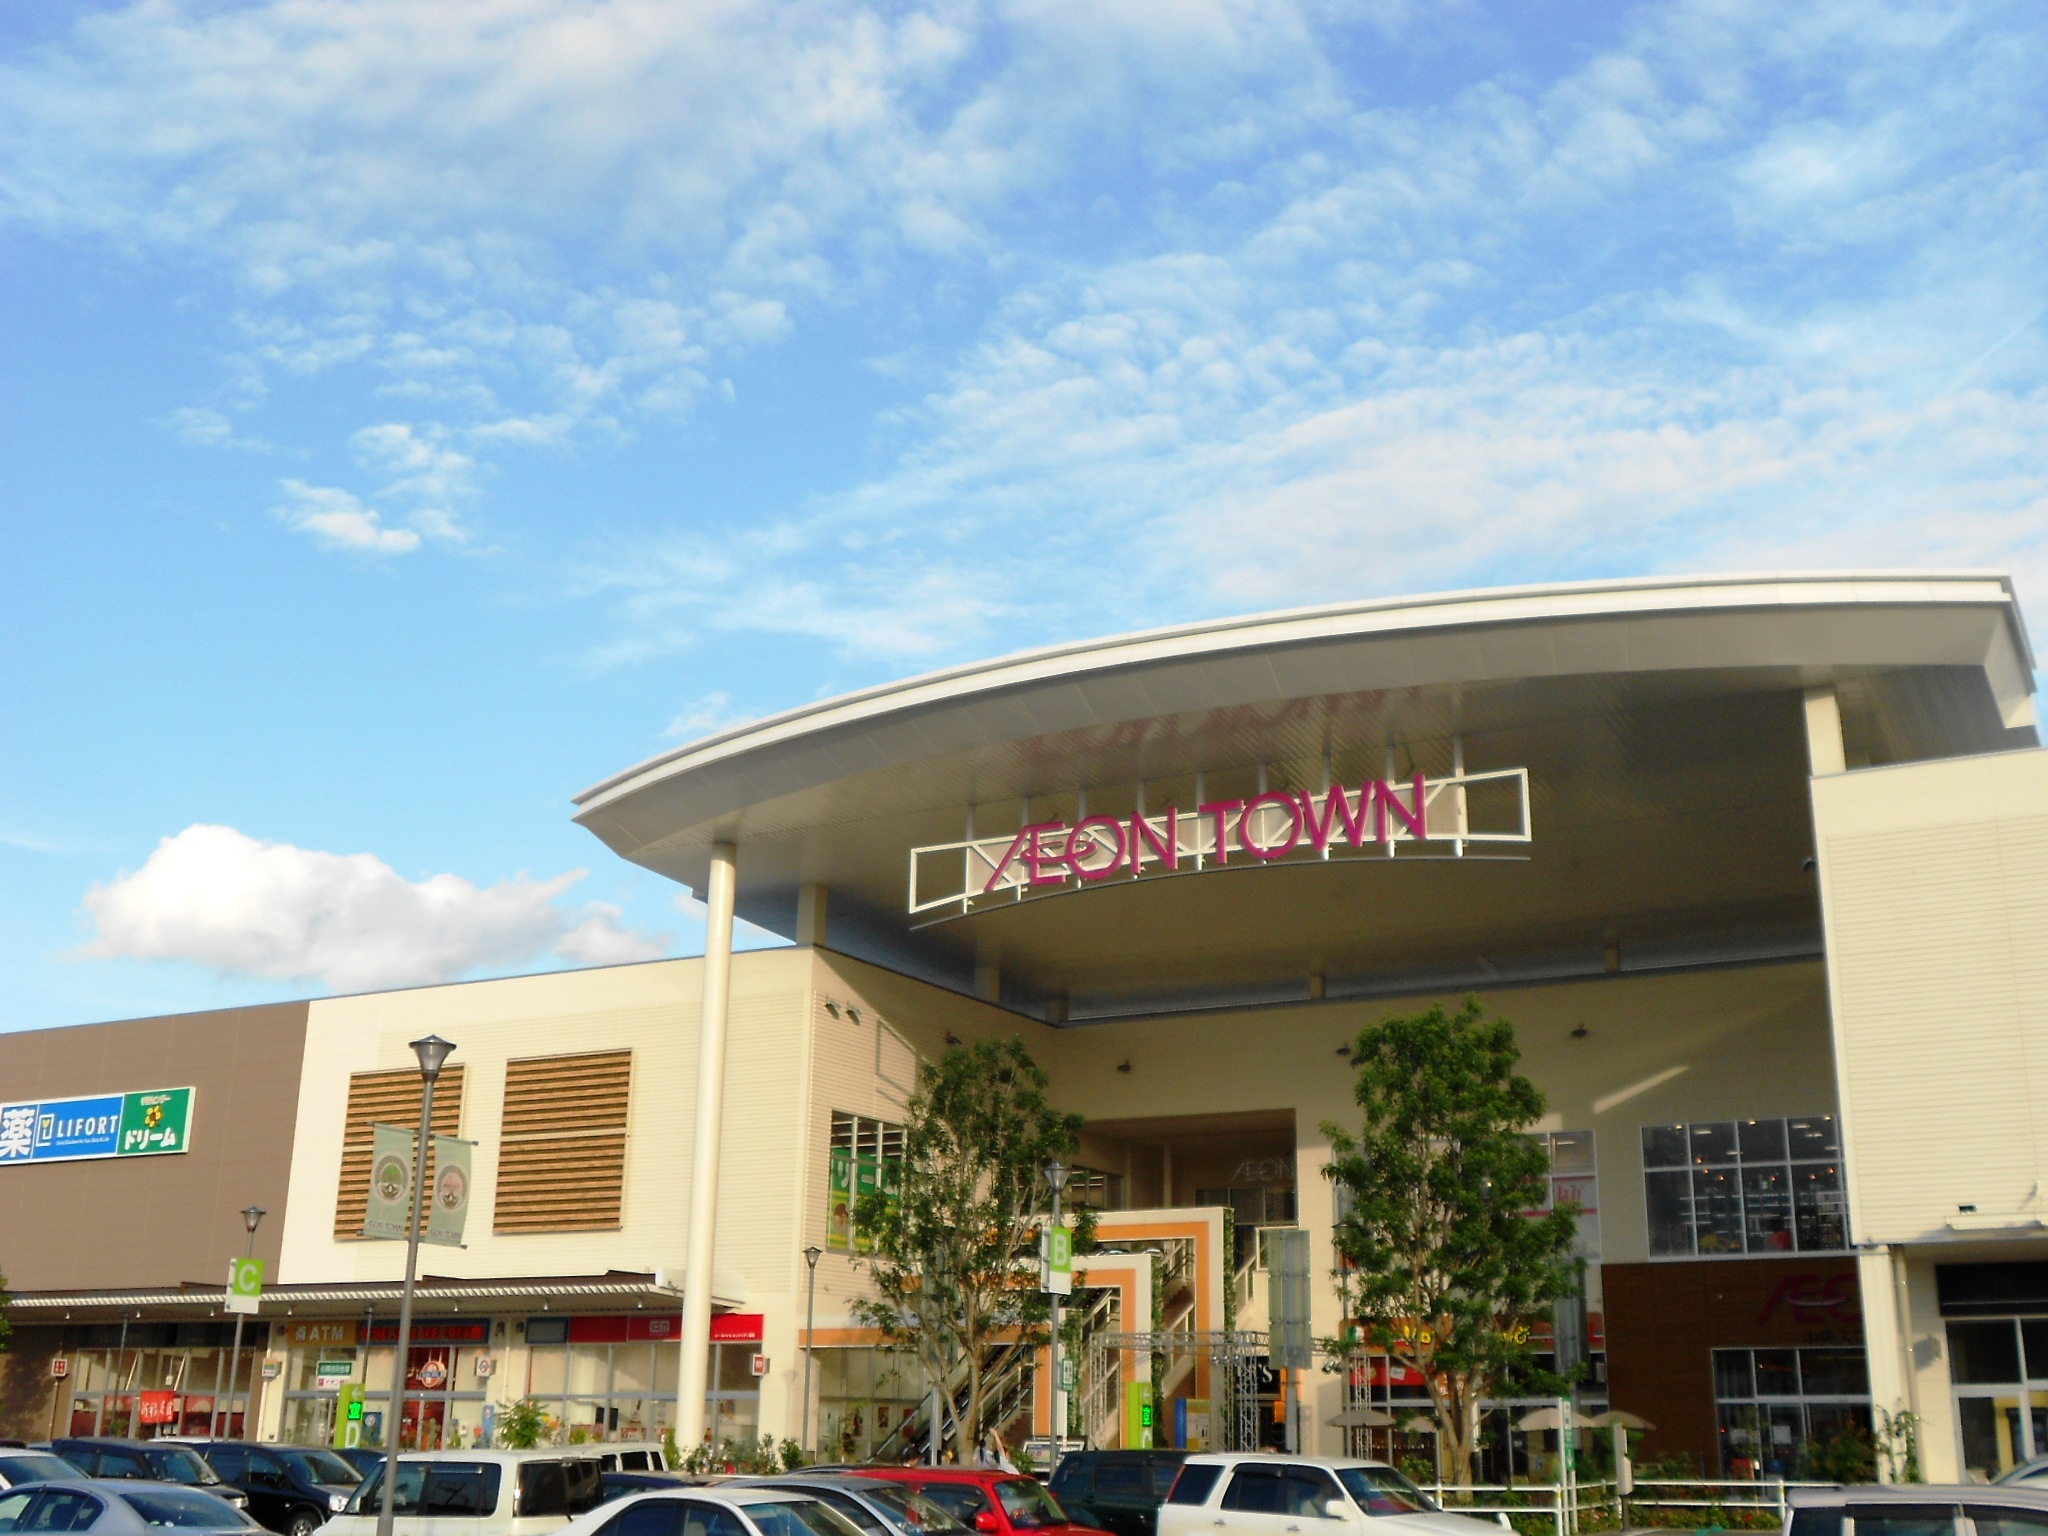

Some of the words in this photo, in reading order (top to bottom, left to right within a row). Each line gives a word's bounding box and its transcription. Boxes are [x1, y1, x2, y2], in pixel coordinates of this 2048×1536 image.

[1198, 773, 1427, 865] TOWN
[0, 1108, 36, 1157] 薬
[57, 1115, 119, 1138] LIFORT
[124, 1127, 177, 1151] ドリーム
[1053, 1234, 1068, 1267] B
[239, 1264, 258, 1292] C
[309, 1325, 344, 1342] ATM
[345, 1421, 361, 1449] D
